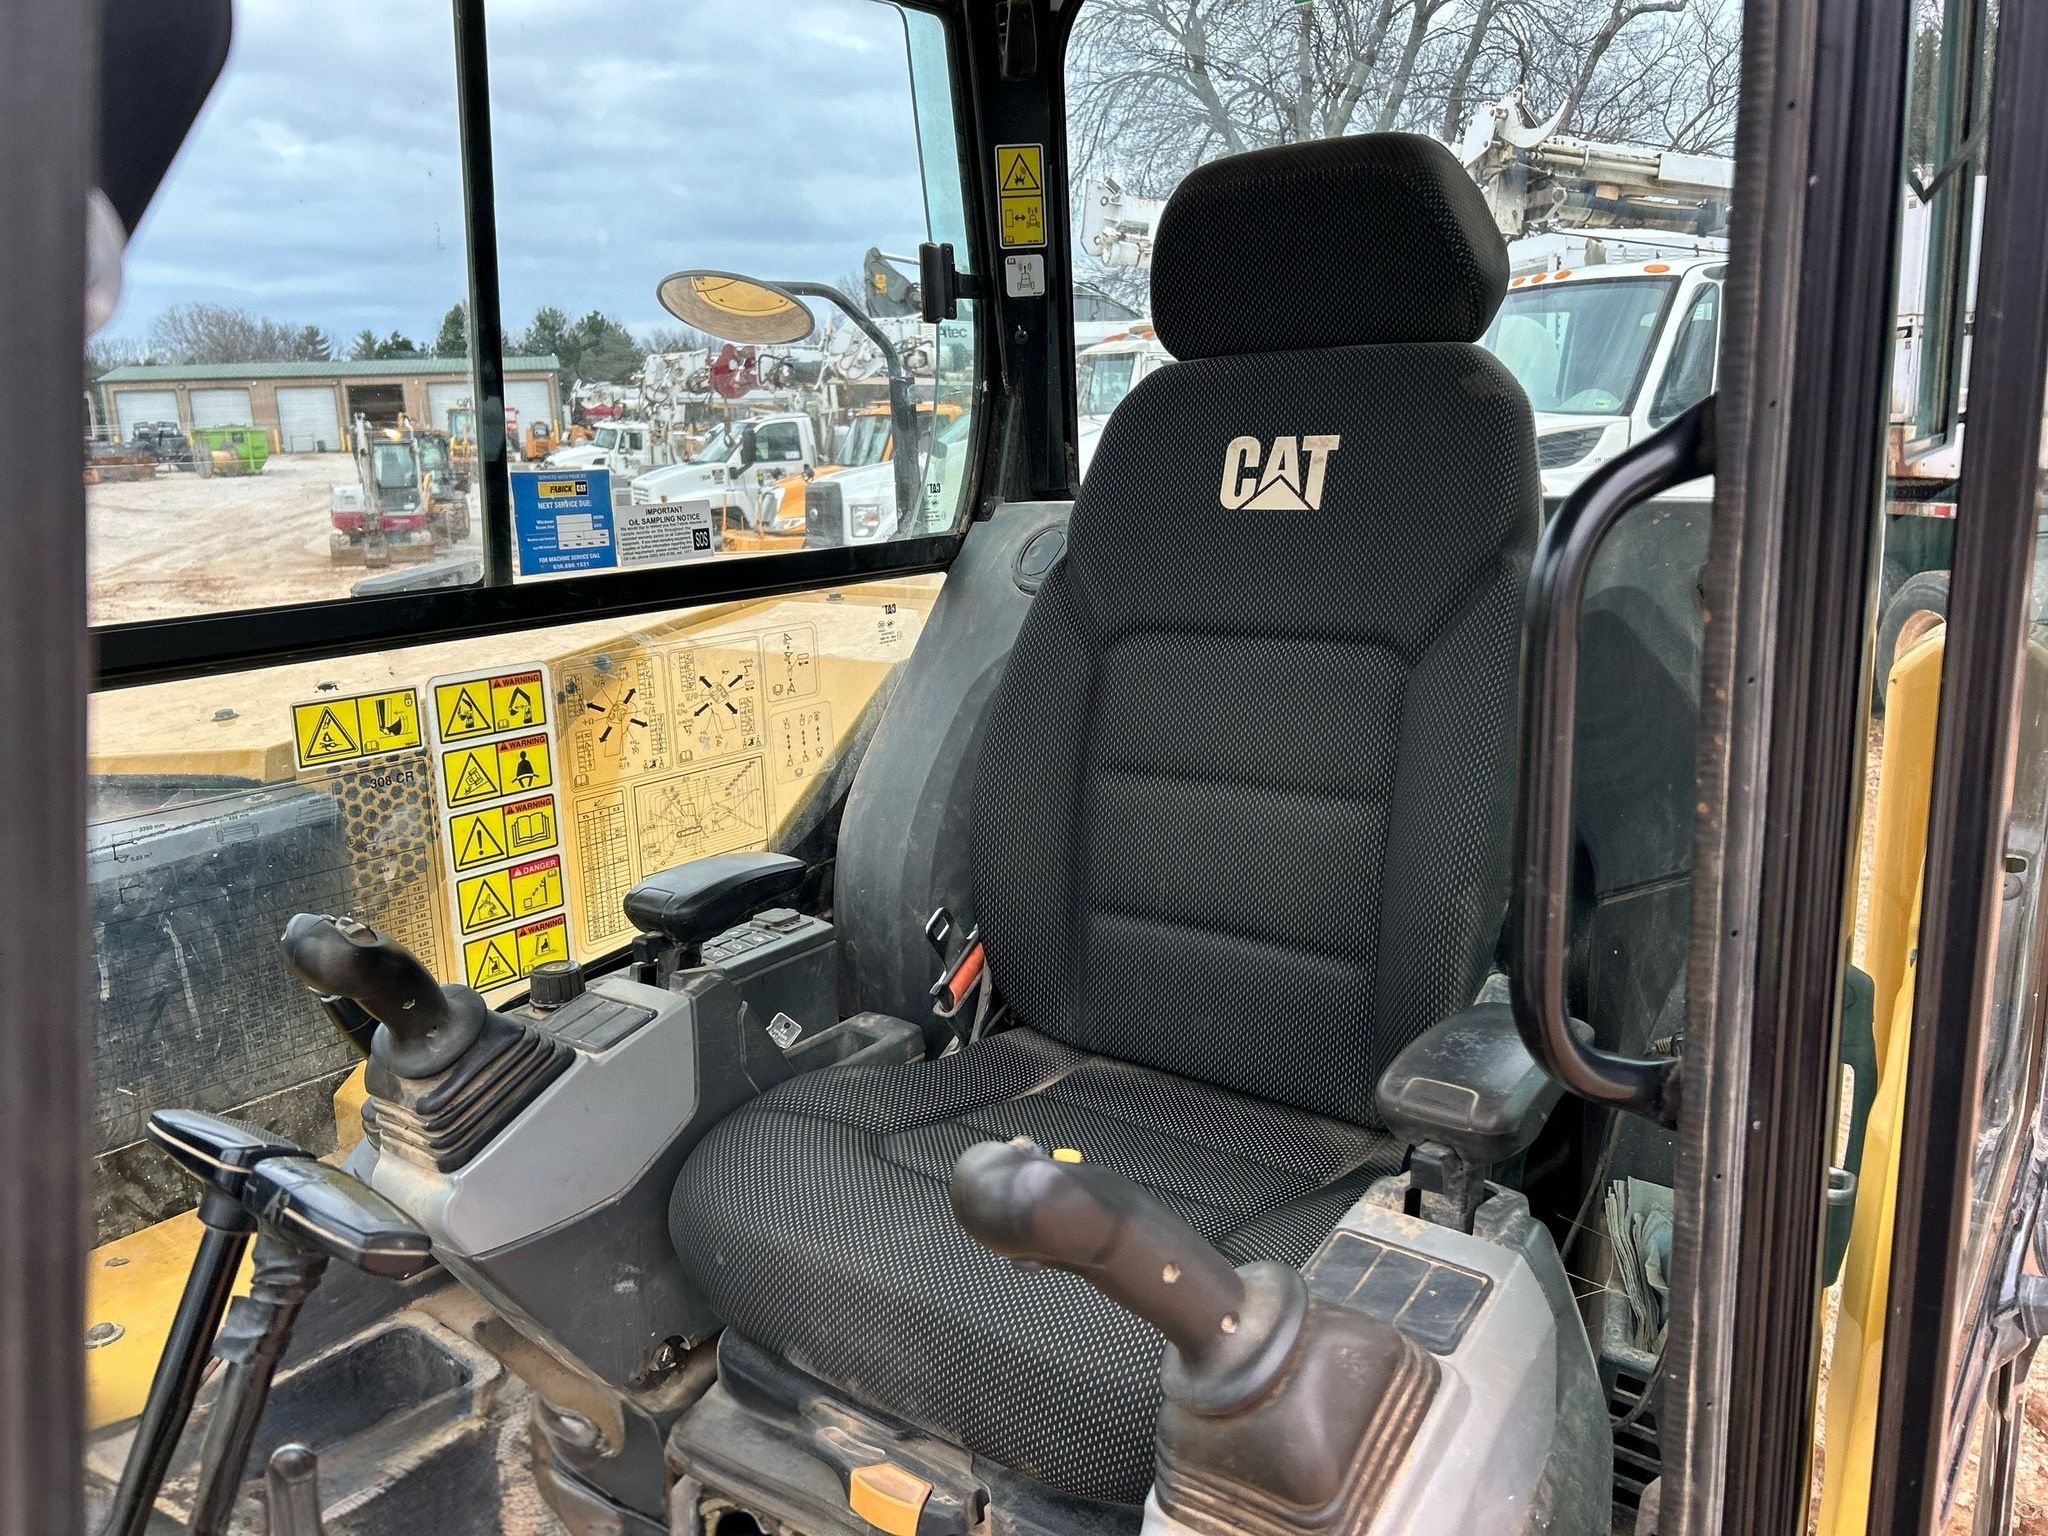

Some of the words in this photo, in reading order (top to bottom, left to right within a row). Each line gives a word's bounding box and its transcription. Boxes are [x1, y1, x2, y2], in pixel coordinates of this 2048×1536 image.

[1220, 435, 1340, 510] CAT
[550, 485, 573, 493] FABICK
[576, 484, 587, 492] CAT
[538, 502, 553, 510] NEXT
[554, 500, 578, 508] SERVICE
[645, 506, 683, 515] IMPORTANT
[641, 516, 675, 525] SAMPLING
[677, 513, 700, 521] NOTICE
[695, 531, 708, 547] SOS
[502, 675, 539, 686] WARNING
[509, 736, 545, 748] WARNING
[370, 776, 392, 788] 308
[396, 771, 414, 783] CR
[515, 798, 550, 812] WARNING
[523, 860, 556, 875] DANGER
[528, 917, 563, 934] WARNING
